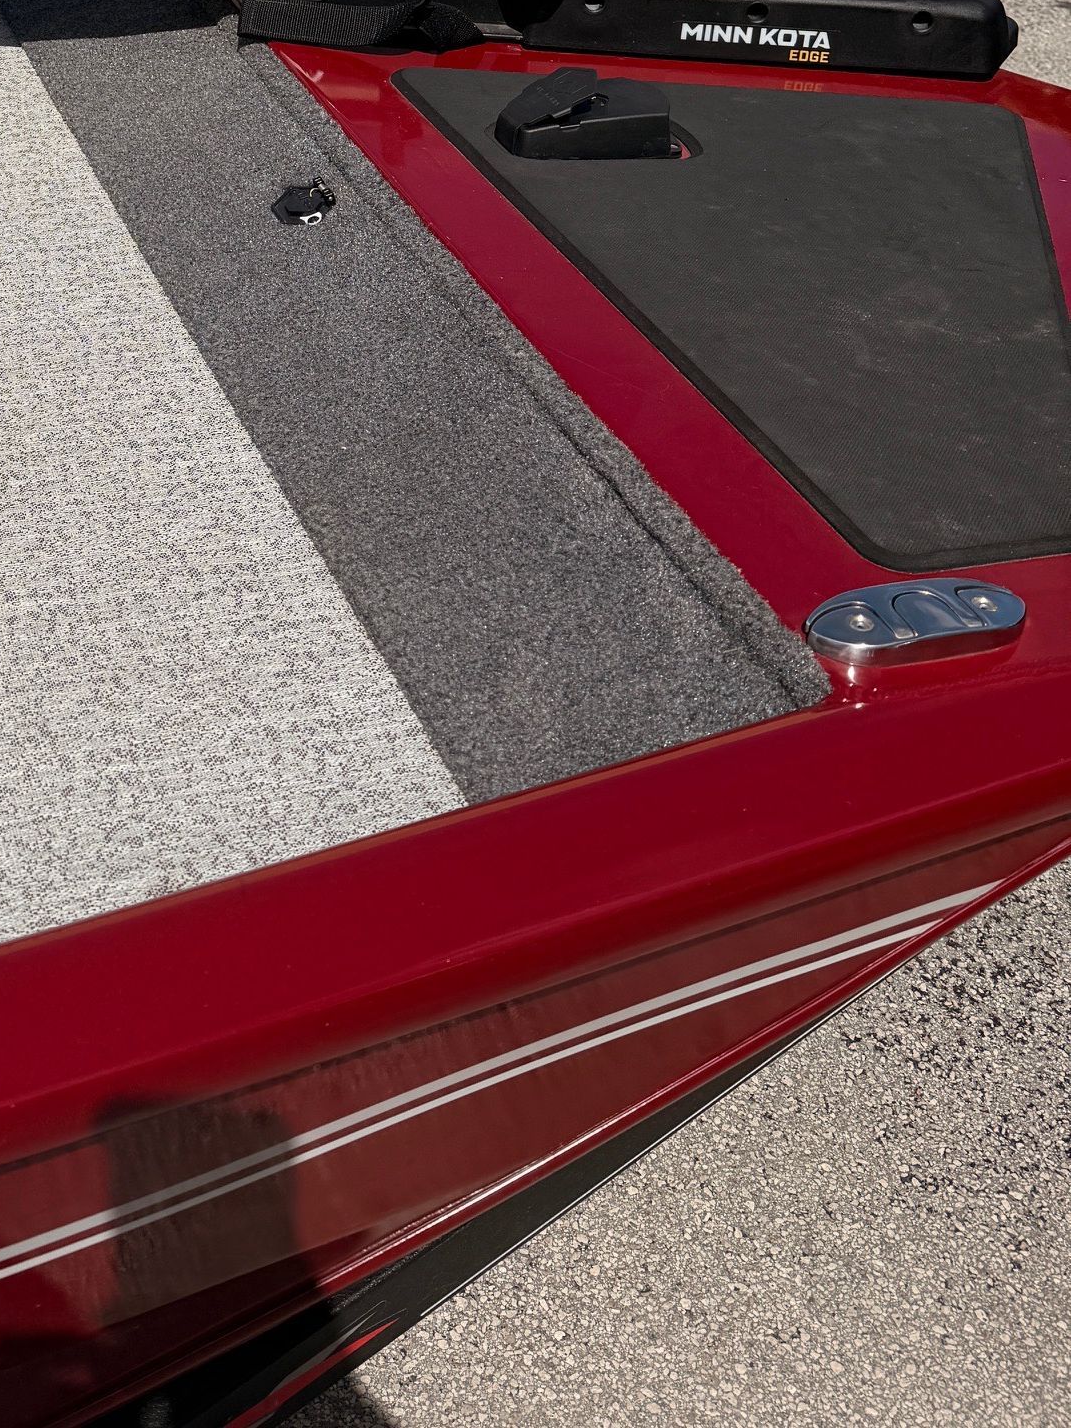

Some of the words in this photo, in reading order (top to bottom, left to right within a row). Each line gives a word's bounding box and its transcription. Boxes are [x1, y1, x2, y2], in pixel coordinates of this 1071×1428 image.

[680, 23, 754, 44] MINN
[759, 28, 831, 50] KOTA
[788, 50, 830, 63] EDGE
